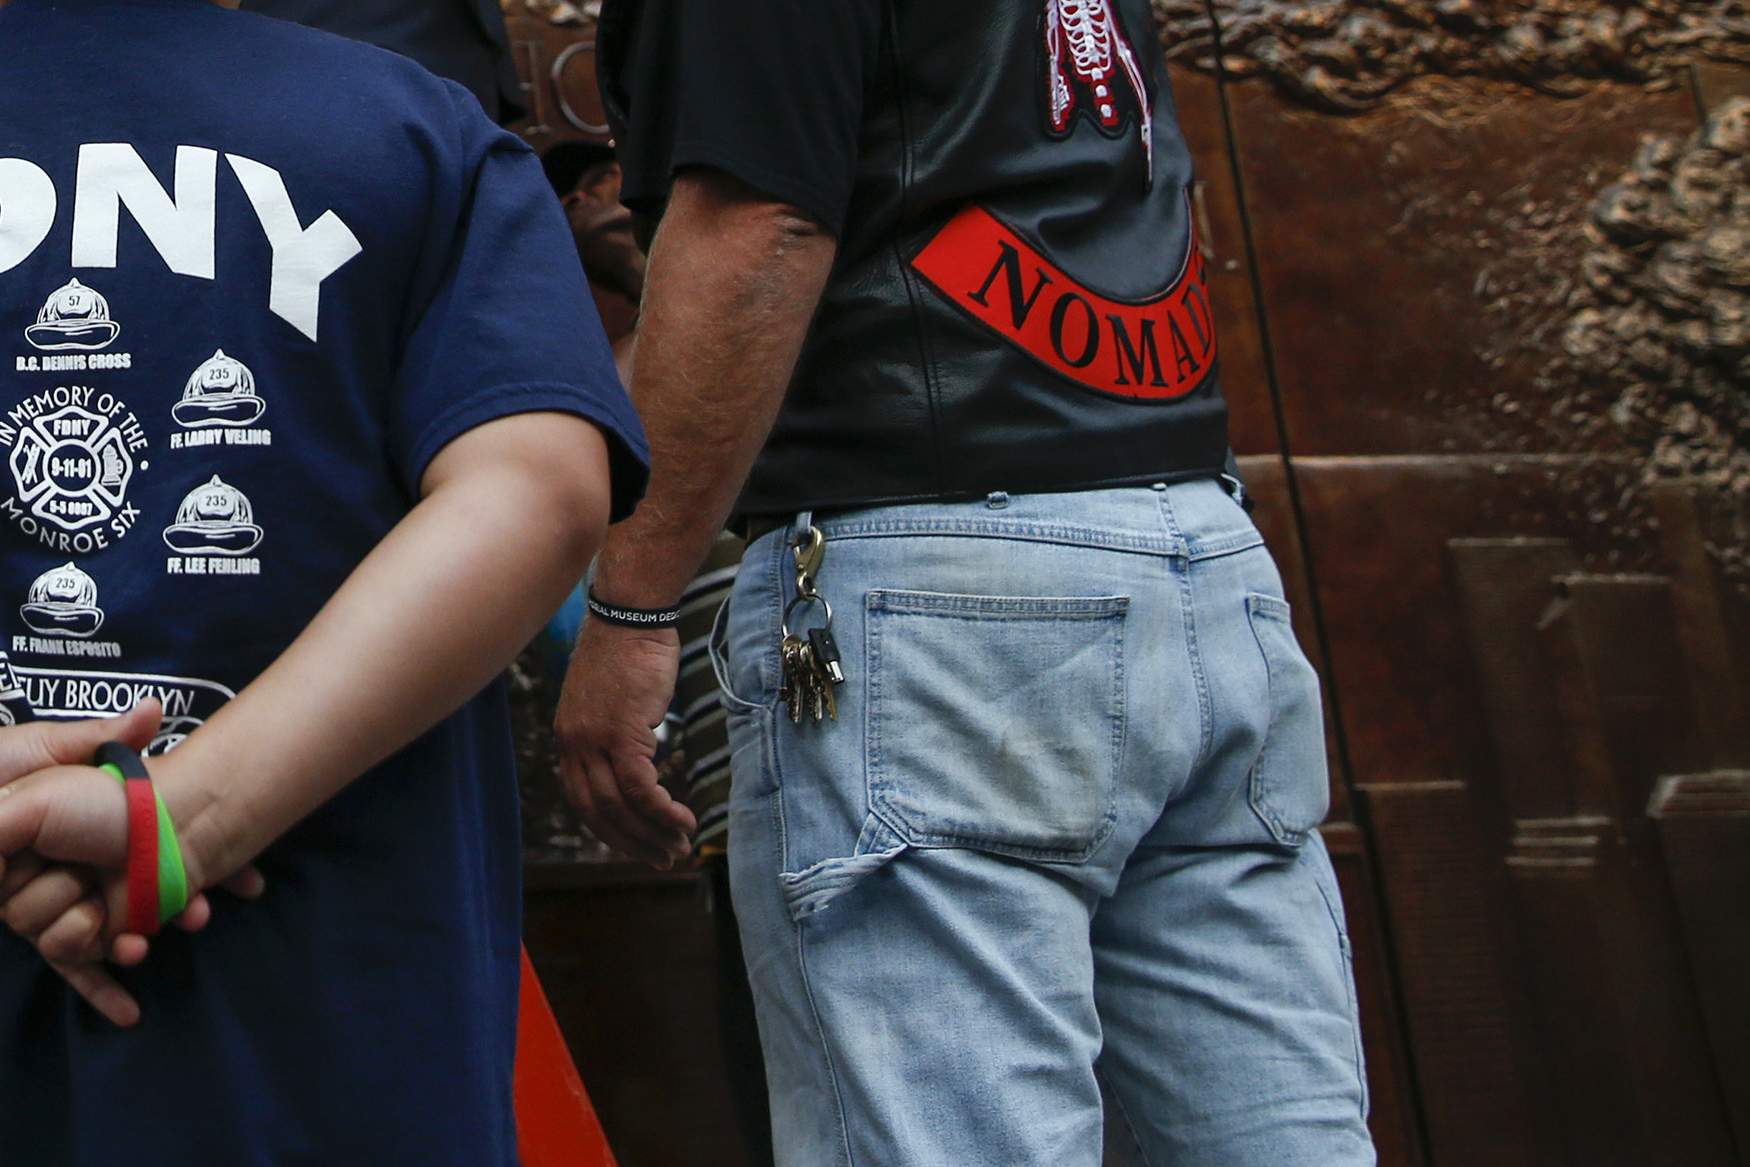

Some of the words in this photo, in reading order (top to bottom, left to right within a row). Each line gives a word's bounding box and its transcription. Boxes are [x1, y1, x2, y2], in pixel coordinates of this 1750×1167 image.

[69, 295, 81, 306] 57
[42, 354, 87, 371] DENNIS
[88, 352, 132, 370] CROSS
[209, 369, 229, 380] 235
[8, 386, 95, 427] MEMORY
[97, 393, 125, 418] OF
[119, 412, 148, 453] THE
[53, 419, 91, 436] FDNY
[185, 428, 223, 447] LARRY
[224, 428, 272, 446] VELING
[51, 456, 92, 479] 9-11-01
[205, 495, 228, 506] 235
[0, 496, 109, 553] MONROE
[111, 500, 141, 538] SIX
[167, 557, 183, 573] FF.
[184, 557, 207, 574] LEE
[208, 557, 261, 575] FEHLING
[56, 577, 75, 589] 235
[610, 609, 657, 622] MUSEUM
[12, 635, 28, 652] FF.
[29, 637, 65, 655] FRANK
[65, 639, 122, 658] ESPOSITO
